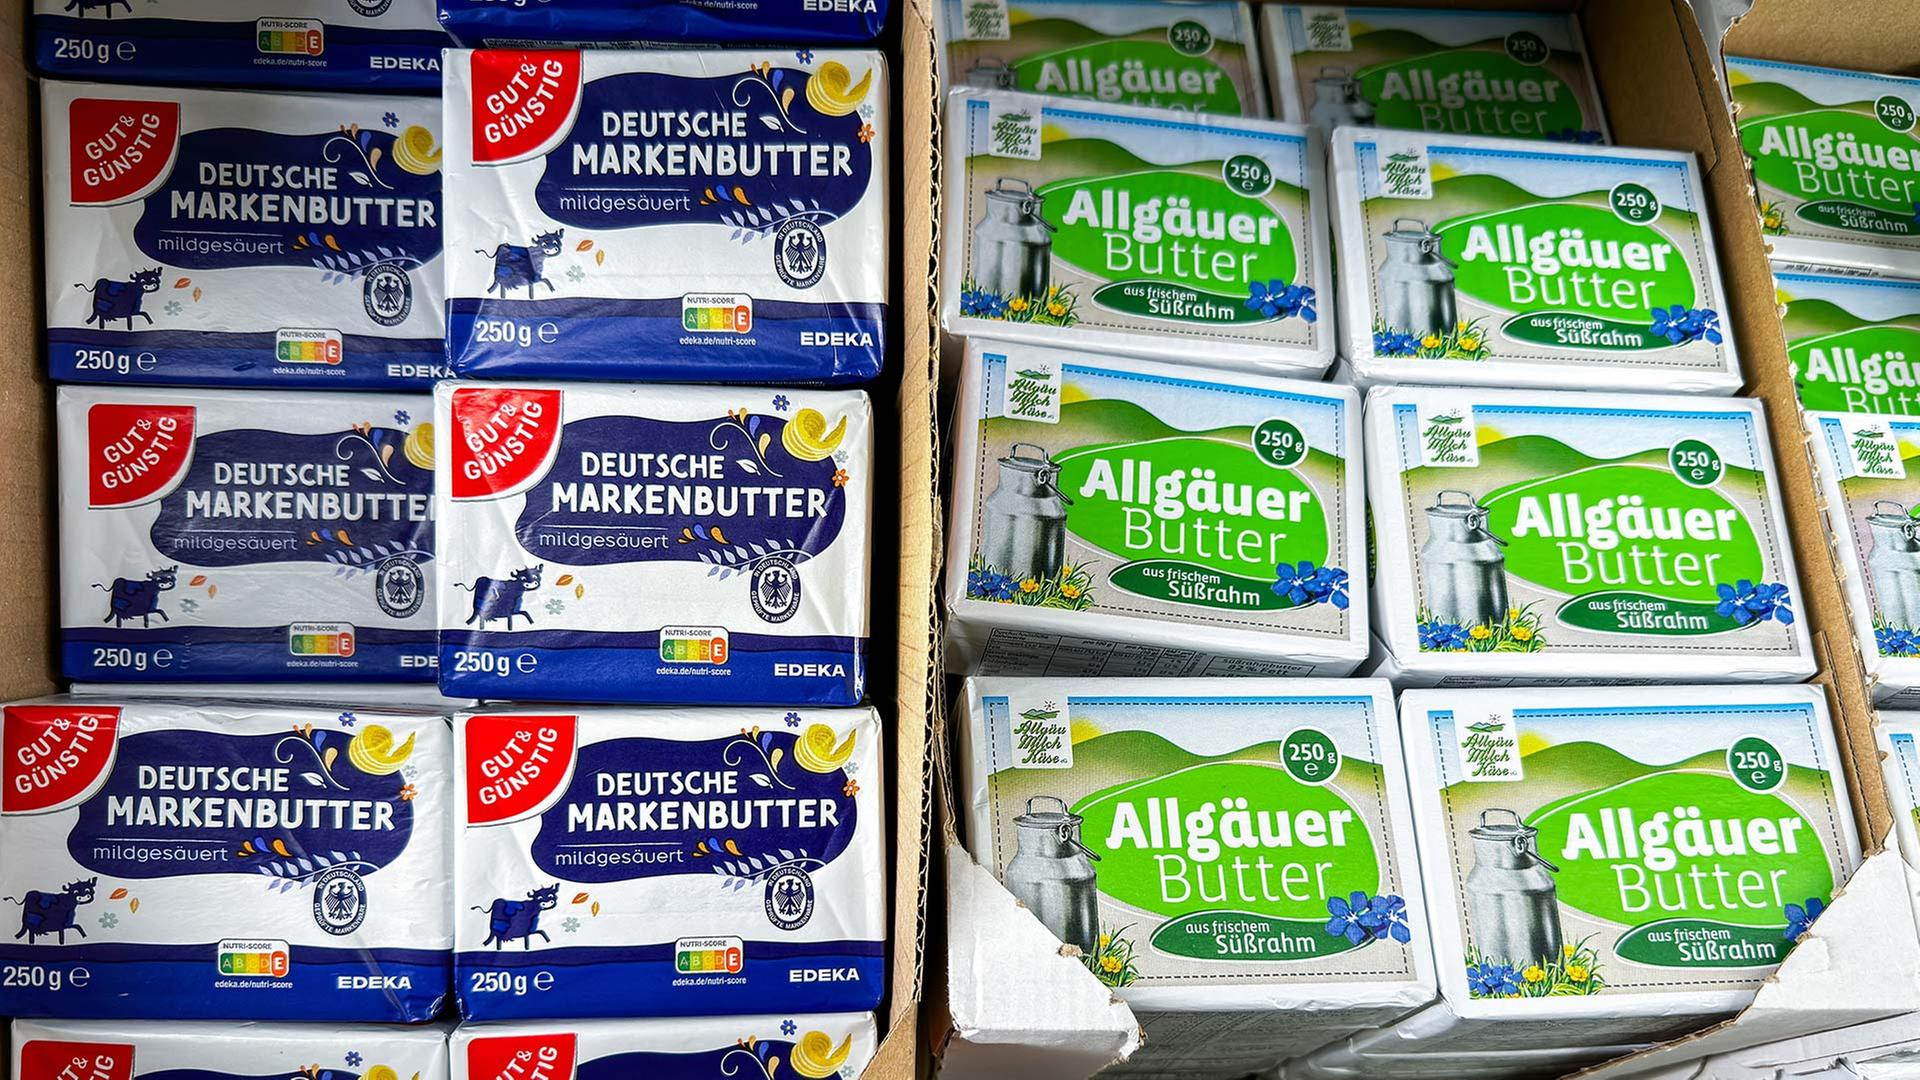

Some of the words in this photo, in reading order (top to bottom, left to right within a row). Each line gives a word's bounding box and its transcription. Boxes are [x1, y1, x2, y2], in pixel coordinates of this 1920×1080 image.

[803, 0, 877, 13] EDEKA
[54, 37, 93, 58] 250
[370, 56, 440, 71] EDEKA
[486, 63, 537, 114] GUT&
[1036, 58, 1221, 100] Allgäuer
[1380, 68, 1560, 109] Allgäuer
[485, 58, 563, 143] GÜNSTIG
[1880, 103, 1905, 118] 250
[602, 111, 747, 137] DEUTSCHE
[1416, 103, 1548, 135] Butter
[85, 114, 135, 161] GUT&
[83, 113, 160, 187] GÜNSTIG
[573, 143, 853, 177] MARKENBUTTER
[200, 162, 338, 190] DEUTSCHE
[1230, 164, 1260, 180] 250
[1792, 161, 1915, 203] Butter
[171, 190, 437, 228] MARKENBUTTER
[559, 194, 690, 213] mildgesäuert
[1617, 192, 1646, 208] 250
[1818, 204, 1835, 213] aus
[1062, 189, 1280, 244] Allgäuer
[1840, 214, 1908, 233] Süßrahm
[158, 236, 284, 255] mildgesäuert
[1461, 223, 1671, 276] Allgäuer
[1103, 233, 1258, 284] Butter
[1123, 287, 1145, 297] aus
[1146, 287, 1197, 301] frischem
[1503, 265, 1656, 310] Butter
[687, 296, 736, 304] NUTRI-SCORE
[1148, 298, 1235, 321] Süßrahm
[476, 321, 516, 343] 250
[1530, 318, 1551, 328] aus
[1552, 318, 1603, 332] frischem
[679, 336, 756, 346] edeka.de/nutri-score
[800, 331, 874, 347] EDEKA
[1557, 328, 1642, 347] Süßrahm
[75, 350, 114, 370] 250
[388, 364, 457, 379] EDEKA
[466, 402, 517, 454] GUT&
[1260, 429, 1292, 448] 250
[103, 417, 152, 464] GUT&
[464, 400, 542, 480] GÜNSTIG
[102, 415, 177, 489] GÜNSTIG
[1675, 450, 1709, 468] 250
[214, 462, 350, 487] DEUTSCHE
[581, 451, 725, 479] DEUTSCHE
[551, 482, 827, 519] MARKENBUTTER
[1080, 458, 1310, 523] Allgäuer
[1512, 492, 1736, 549] Allgäuer
[173, 535, 298, 552] mildgesäuert
[539, 529, 669, 550] mildgesäuert
[1122, 506, 1287, 565] Butter
[1556, 542, 1721, 586] Butter
[1142, 567, 1164, 577] aus
[1166, 567, 1221, 584] frischem
[1168, 580, 1261, 607] Süßrahm
[1588, 600, 1611, 611] aus
[1612, 600, 1666, 614] frischem
[1617, 611, 1708, 630] Süßrahm
[665, 629, 713, 637] NUTRI-SCORE
[93, 648, 132, 668] 250
[401, 655, 439, 667] EDE
[454, 651, 494, 673] 250
[655, 667, 731, 677] edeka.de/nutri-score
[774, 663, 846, 678] EDEKA
[17, 718, 71, 767] GUT&
[1288, 742, 1324, 761] 250
[16, 714, 99, 794] GÜNSTIG
[481, 729, 532, 779] GUT&
[1735, 751, 1770, 769] 250
[479, 727, 557, 806] GÜNSTIG
[138, 765, 290, 793] DEUTSCHE
[597, 770, 738, 797] DEUTSCHE
[107, 796, 396, 832] MARKENBUTTER
[567, 798, 840, 833] MARKENBUTTER
[1105, 797, 1353, 862] Allgäuer
[1561, 805, 1802, 872] Allgäuer
[93, 844, 229, 863] mildgesäuert
[555, 847, 684, 866] mildgesäuert
[1154, 853, 1333, 903] Butter
[1611, 862, 1788, 914] Butter
[1185, 923, 1210, 933] aus
[1211, 920, 1270, 935] frischem
[1648, 931, 1672, 941] aus
[1673, 928, 1731, 943] frischem
[223, 942, 273, 950] NUTRI-SCORE
[1215, 934, 1317, 955] Süßrahm
[1678, 941, 1777, 961] Süßrahm
[3, 966, 45, 988] 250
[214, 979, 293, 990] edeka.de/nutri-score
[338, 975, 412, 990] EDEKA
[472, 971, 512, 993] 250
[672, 976, 747, 987] edeka.de/nutri-score
[789, 969, 860, 983] EDEKA
